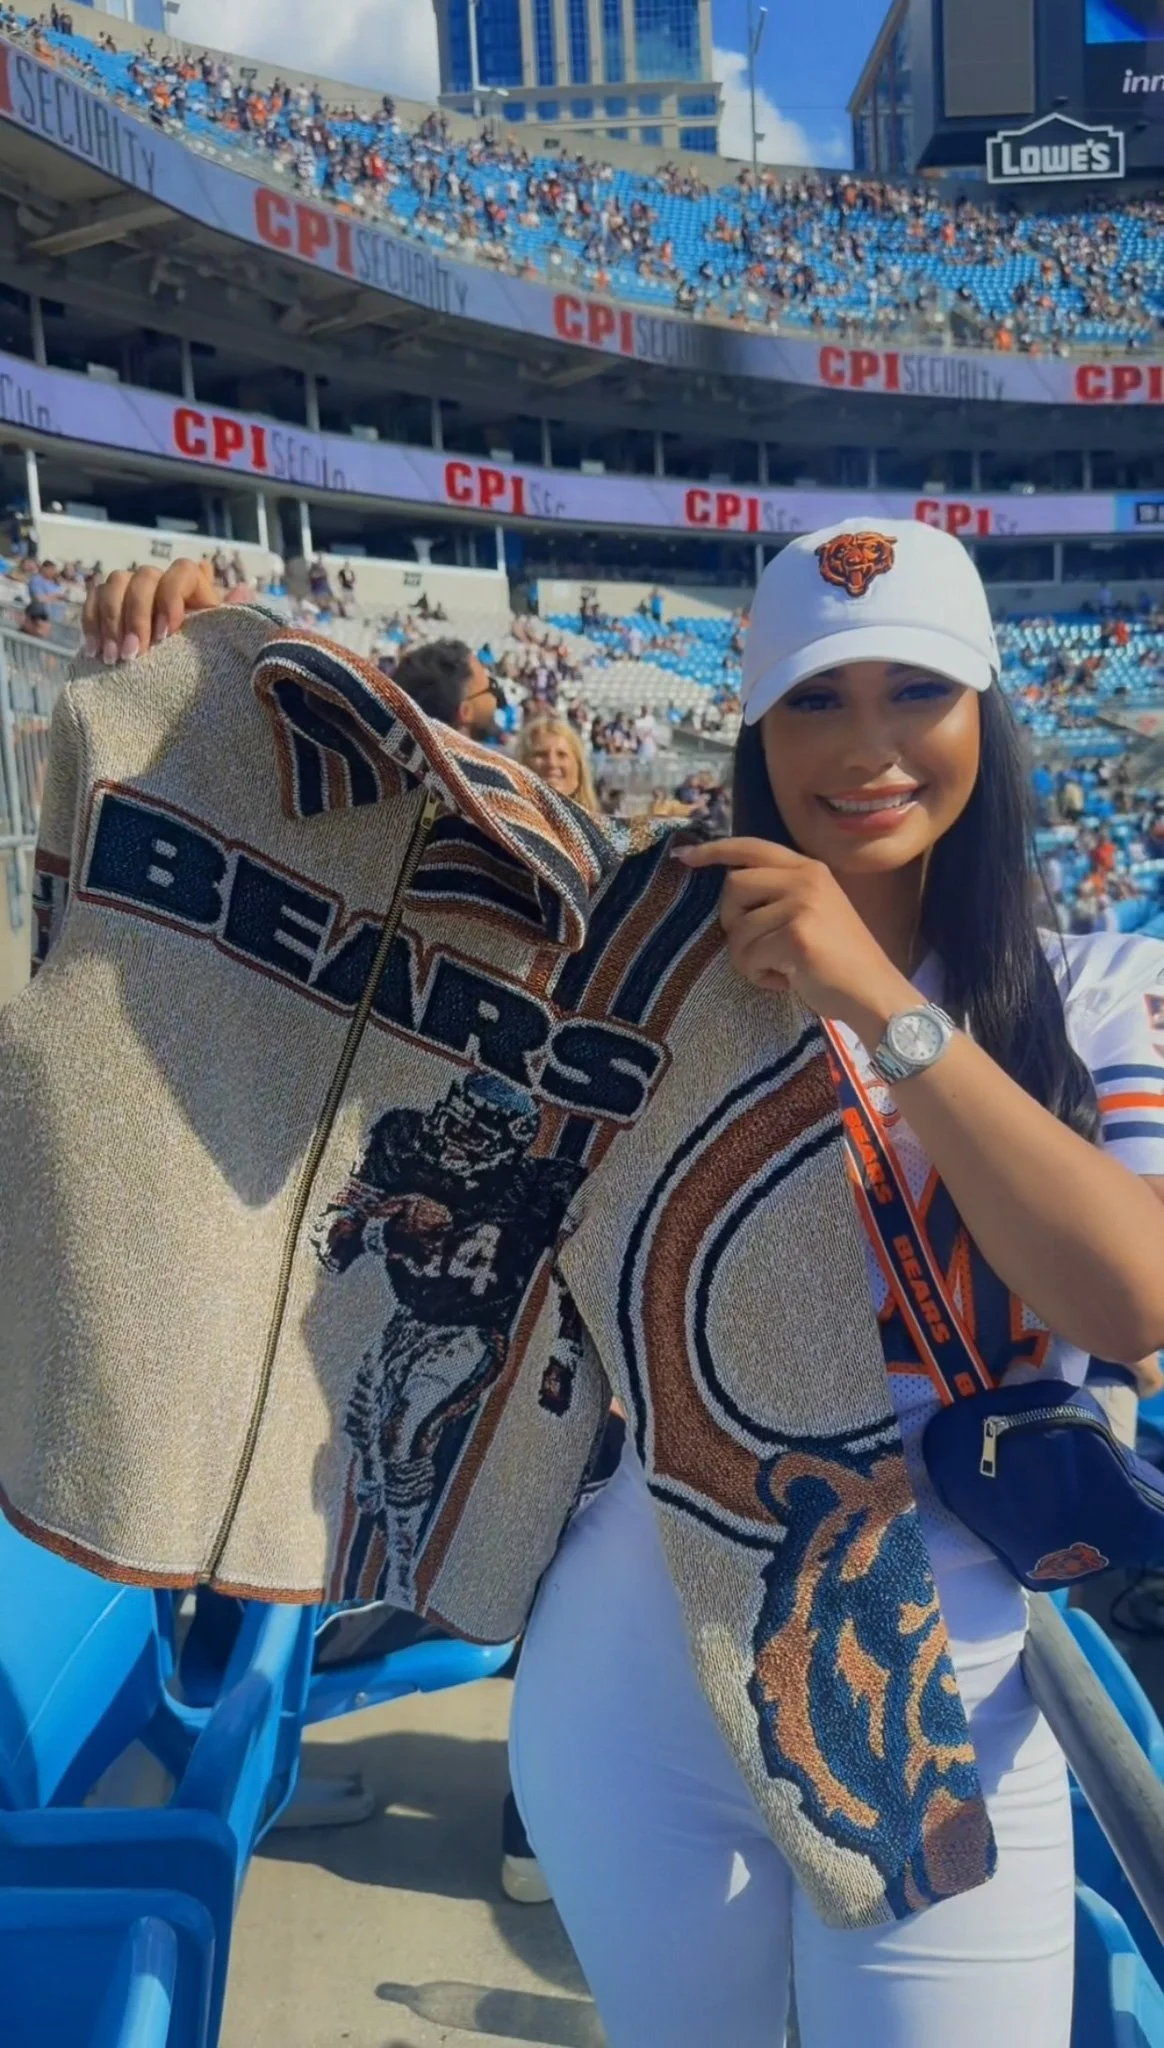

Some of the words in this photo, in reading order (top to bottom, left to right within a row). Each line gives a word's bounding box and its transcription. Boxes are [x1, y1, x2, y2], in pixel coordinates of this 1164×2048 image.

[15, 56, 156, 193] SECURITY
[1001, 138, 1111, 176] LOWE'S
[254, 187, 354, 276] CPI
[553, 293, 634, 356] CPI
[818, 345, 900, 390] CPI
[1075, 364, 1164, 401] CPI
[173, 406, 268, 472] CPI
[445, 461, 526, 517] CPI
[685, 488, 760, 534] CPI
[914, 499, 991, 538] CPI
[80, 787, 668, 1122] BEARS
[841, 1106, 894, 1205] BEARS
[892, 1234, 951, 1344] BEARS
